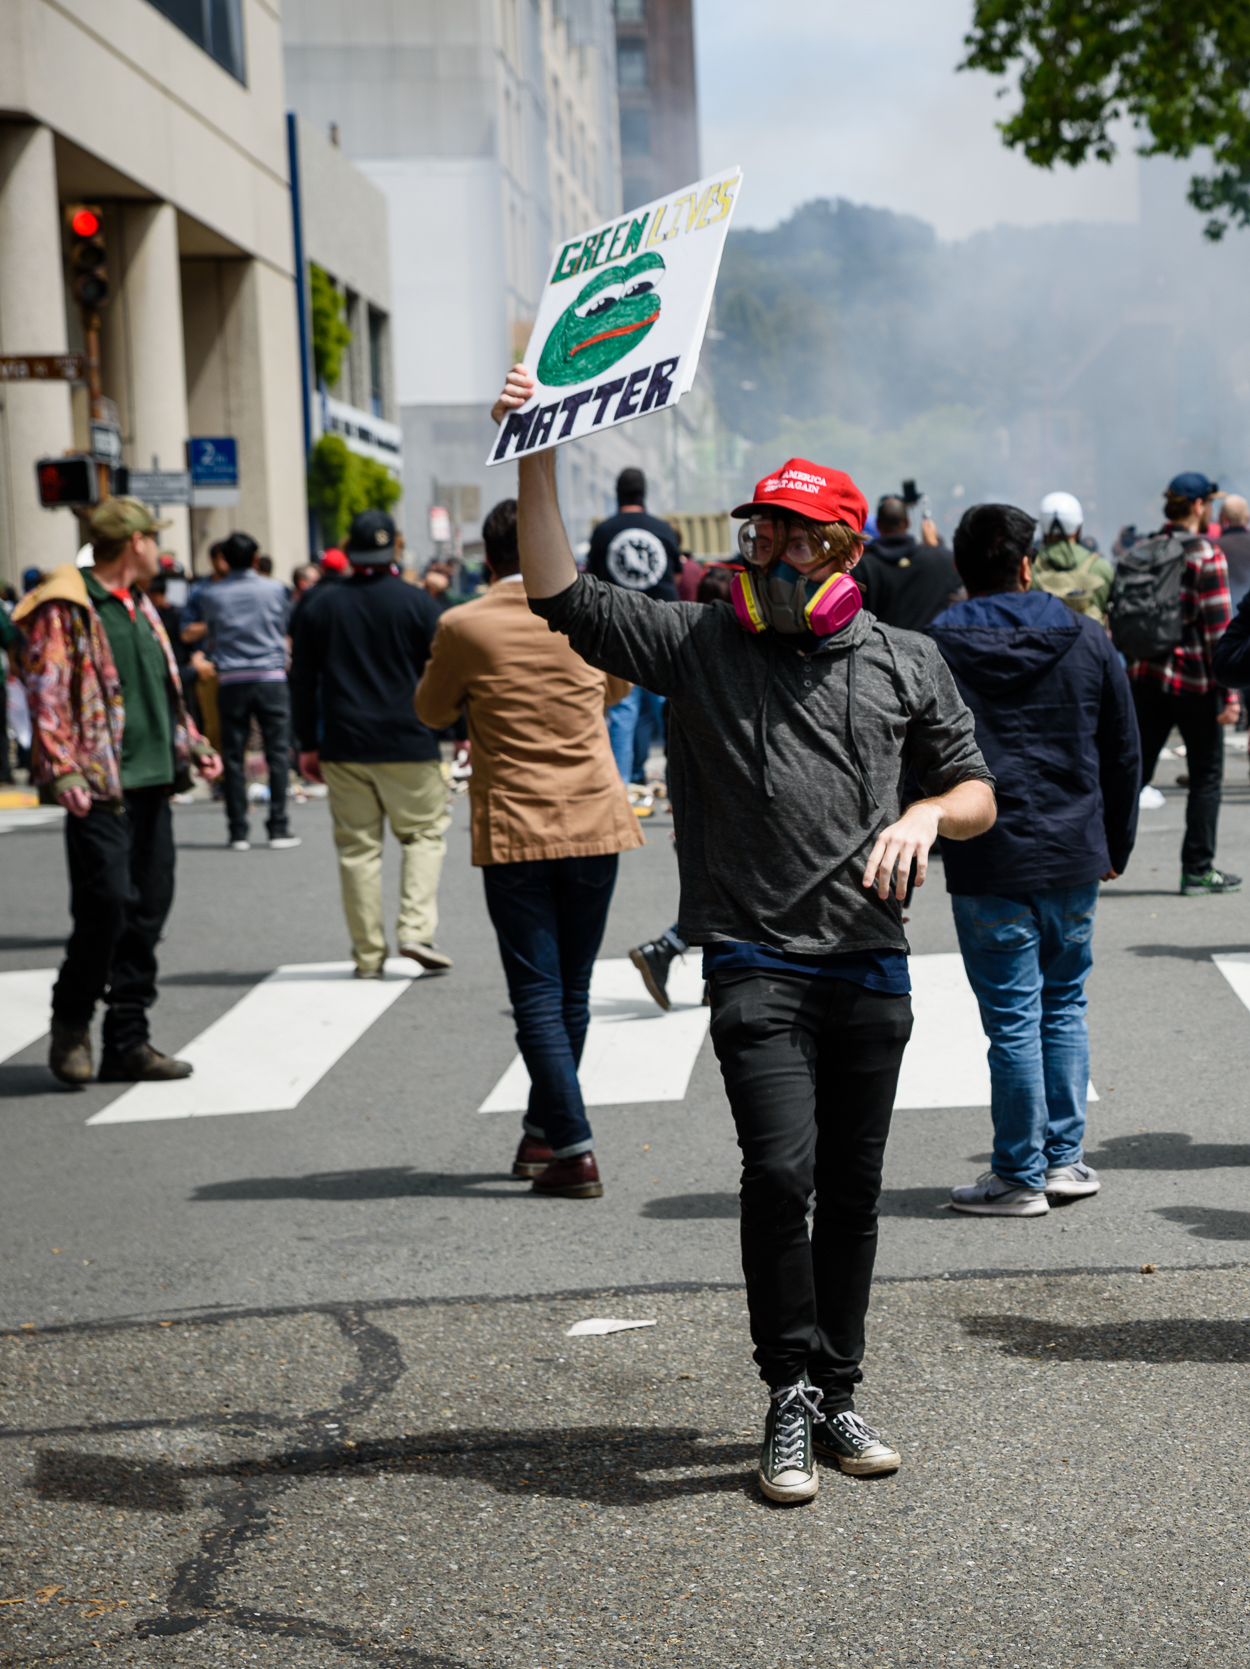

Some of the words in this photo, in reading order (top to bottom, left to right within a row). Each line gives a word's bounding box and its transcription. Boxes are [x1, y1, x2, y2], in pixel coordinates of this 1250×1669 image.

[550, 211, 650, 285] GREEN
[646, 178, 739, 248] LIVES
[493, 355, 681, 461] MATTER
[782, 469, 827, 487] AMERICA
[787, 481, 820, 494] AGAIN
